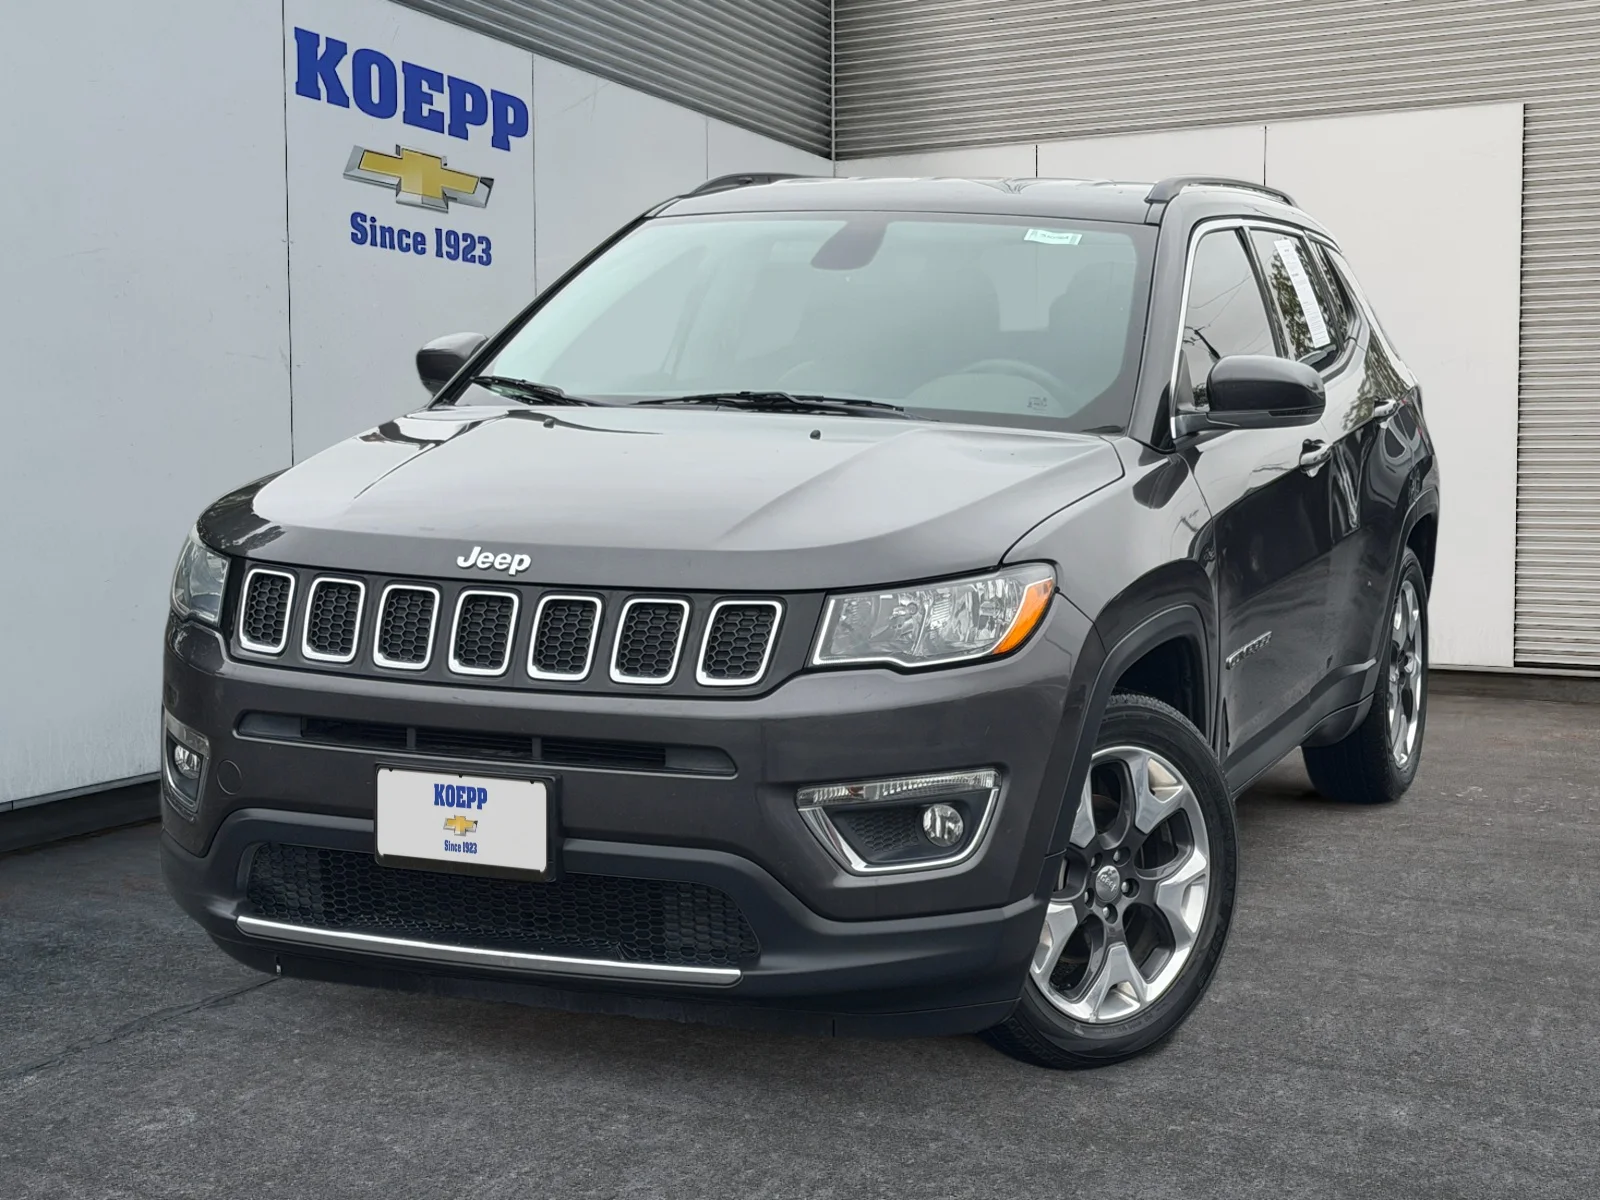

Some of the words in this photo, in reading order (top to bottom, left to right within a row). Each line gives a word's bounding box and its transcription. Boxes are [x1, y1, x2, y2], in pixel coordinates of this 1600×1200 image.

[293, 26, 529, 152] KOEPP
[350, 211, 427, 256] Since
[434, 227, 493, 267] 1923
[456, 545, 532, 576] Jeep
[433, 783, 488, 810] KOEPP
[444, 839, 461, 853] Since
[462, 841, 478, 854] 1923
